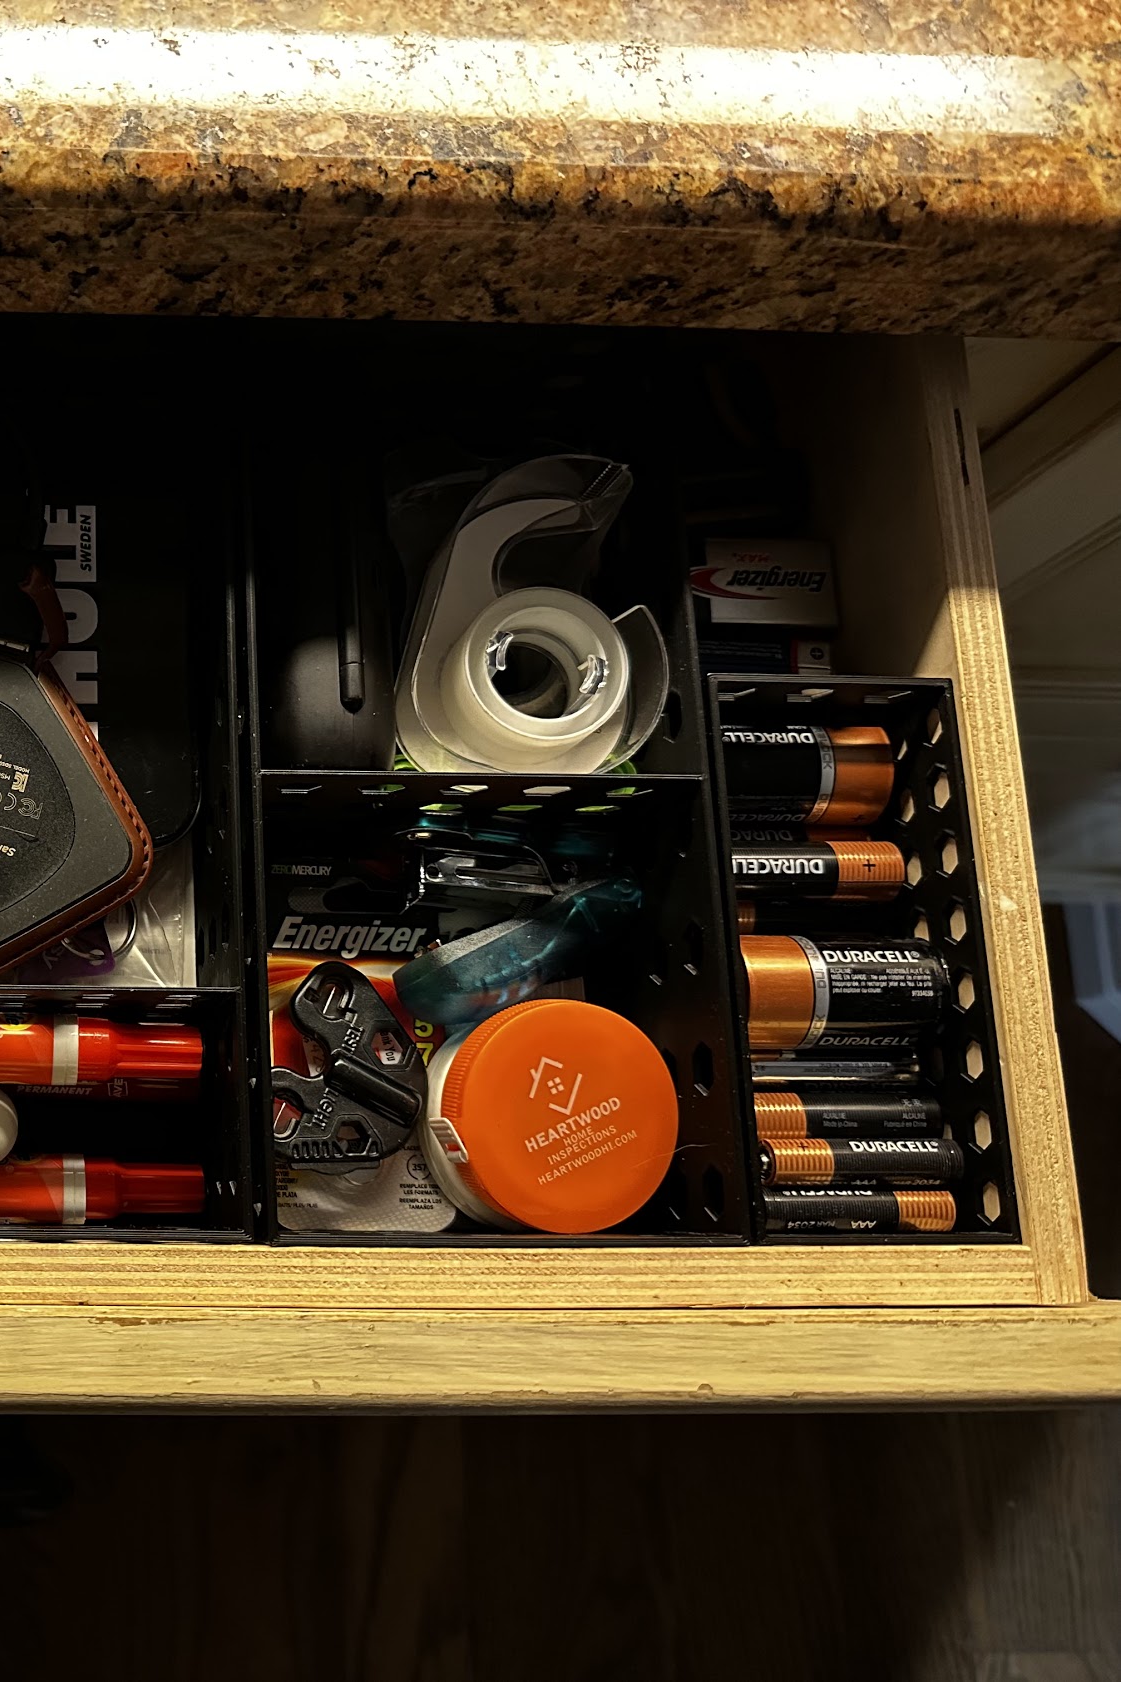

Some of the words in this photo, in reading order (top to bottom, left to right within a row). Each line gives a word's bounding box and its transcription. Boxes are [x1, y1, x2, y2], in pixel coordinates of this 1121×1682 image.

[80, 514, 91, 571] SWEDEN
[726, 566, 826, 592] Energizer
[725, 732, 815, 744] DURACELL
[271, 915, 427, 960] Energizer
[821, 950, 919, 963] DURACELL
[818, 1036, 910, 1046] DURACELL
[16, 1085, 92, 1096] PERMANENT
[524, 1097, 621, 1153] HEARTWOOD
[547, 1125, 617, 1165] INSPECTIONS
[563, 1126, 595, 1147] HOME
[848, 1141, 938, 1152] DURACELL
[537, 1129, 638, 1185] HEARTWOODHI.COM
[851, 1221, 877, 1229] AAA
